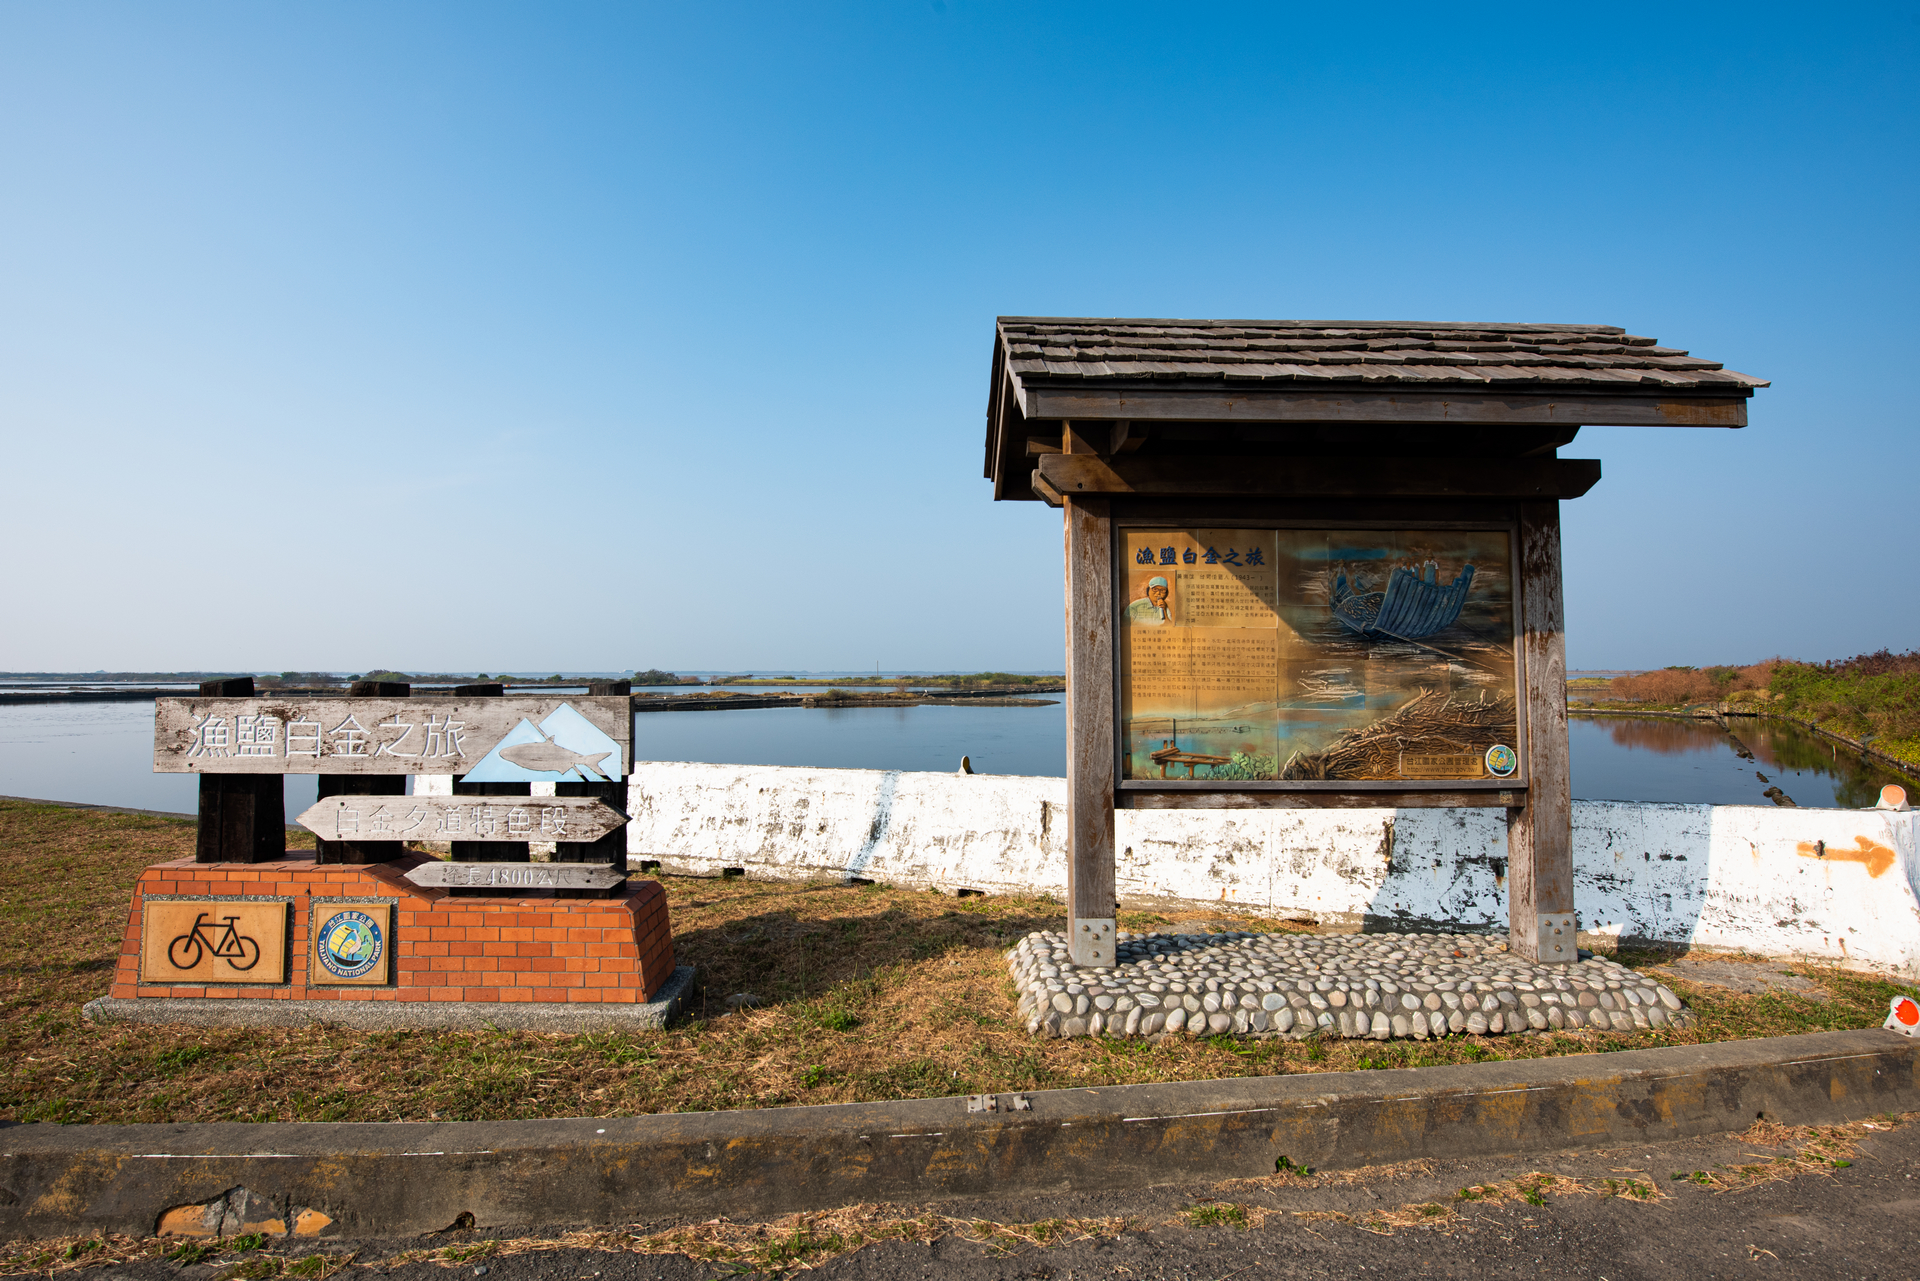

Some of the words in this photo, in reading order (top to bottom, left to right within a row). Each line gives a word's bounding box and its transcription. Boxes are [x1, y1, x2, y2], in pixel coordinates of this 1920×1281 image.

[1136, 546, 1265, 566] 漁鹽白金之旅
[186, 713, 467, 759] 漁鹽白金之旅
[334, 804, 569, 836] 白金夕道特色段
[328, 912, 374, 928] 台江國家公園
[319, 940, 337, 972] TAIJIANG
[337, 961, 374, 977] NATIONAL
[373, 940, 382, 961] PARK
